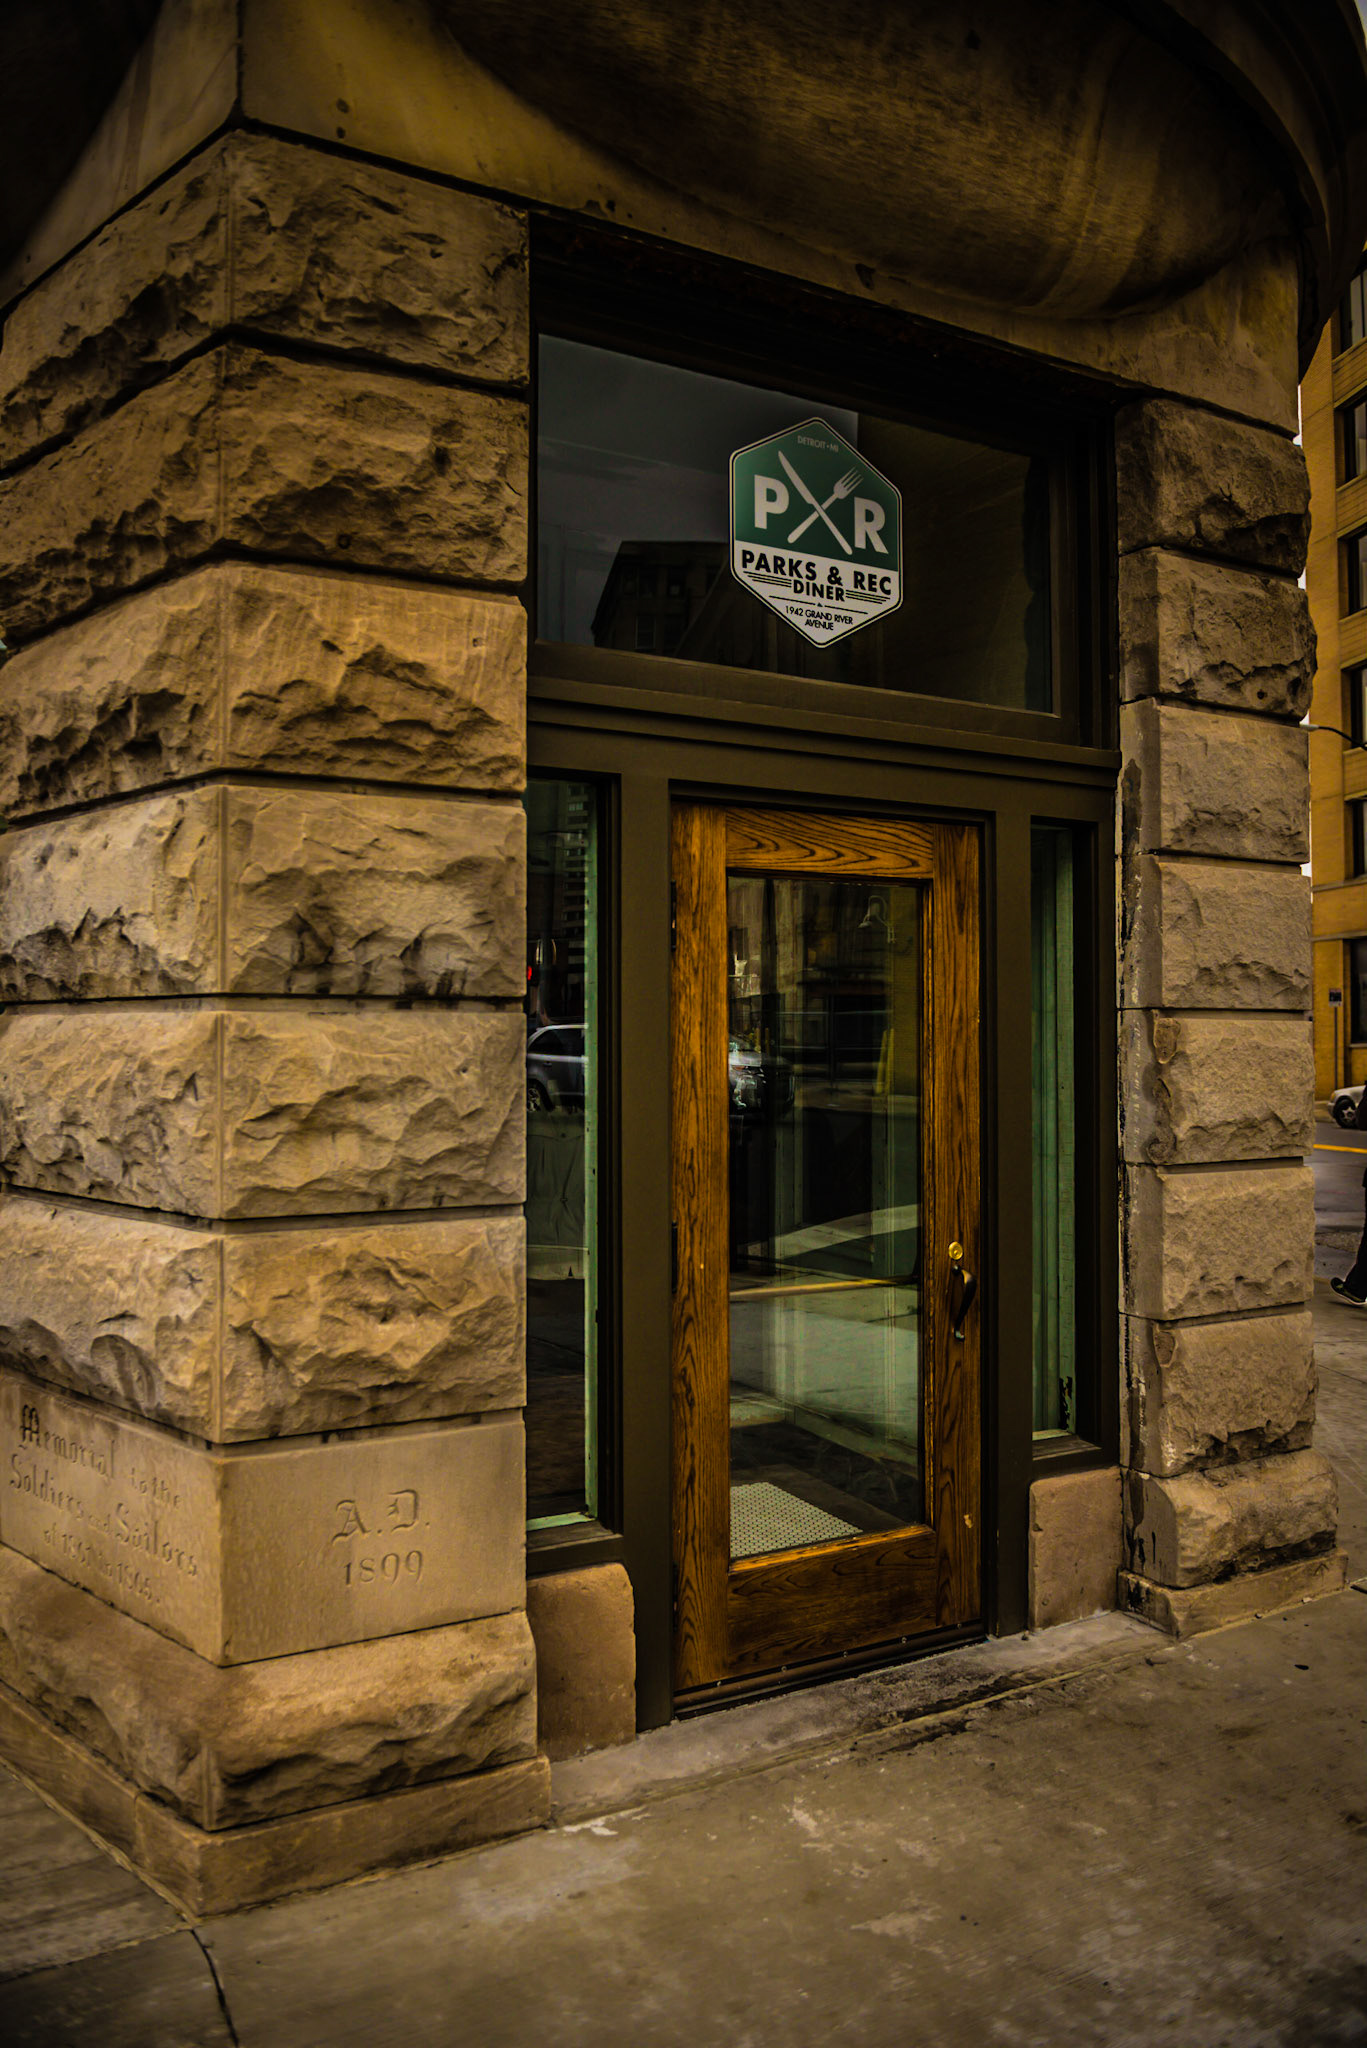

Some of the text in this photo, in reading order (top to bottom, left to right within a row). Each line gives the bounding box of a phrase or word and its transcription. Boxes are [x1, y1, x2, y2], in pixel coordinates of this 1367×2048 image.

[797, 435, 825, 450] DETROIT
[754, 474, 889, 555] P R
[741, 549, 892, 596] PARKS & REC
[793, 579, 845, 602] DINER
[786, 605, 854, 626] 1942 GRAND RIVER
[804, 618, 834, 631] AVENUE
[17, 1404, 115, 1478] Memorial
[9, 1453, 84, 1521] Soldiers
[343, 1550, 423, 1585] 1899
